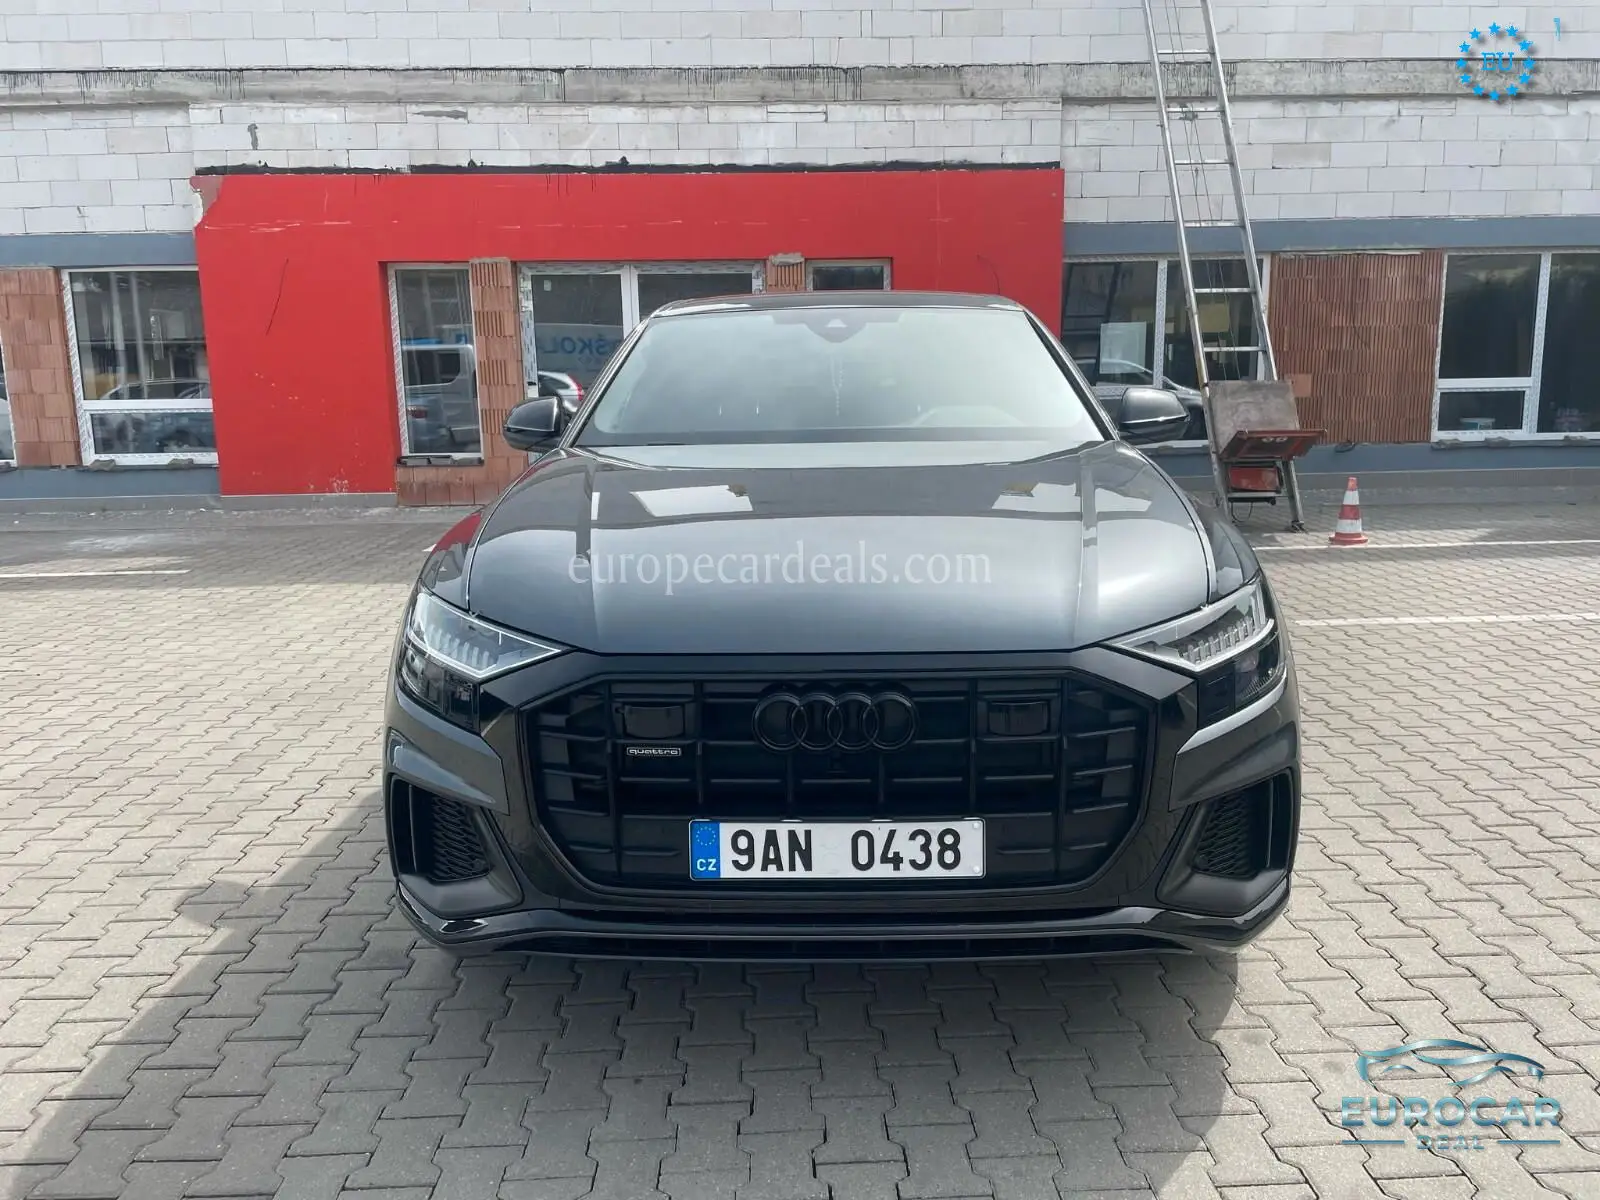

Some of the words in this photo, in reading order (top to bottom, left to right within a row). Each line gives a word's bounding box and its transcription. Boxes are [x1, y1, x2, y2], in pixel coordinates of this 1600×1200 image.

[629, 748, 679, 756] quattro
[730, 829, 813, 872] 9AN
[851, 828, 962, 872] 0438
[696, 858, 717, 872] CZ
